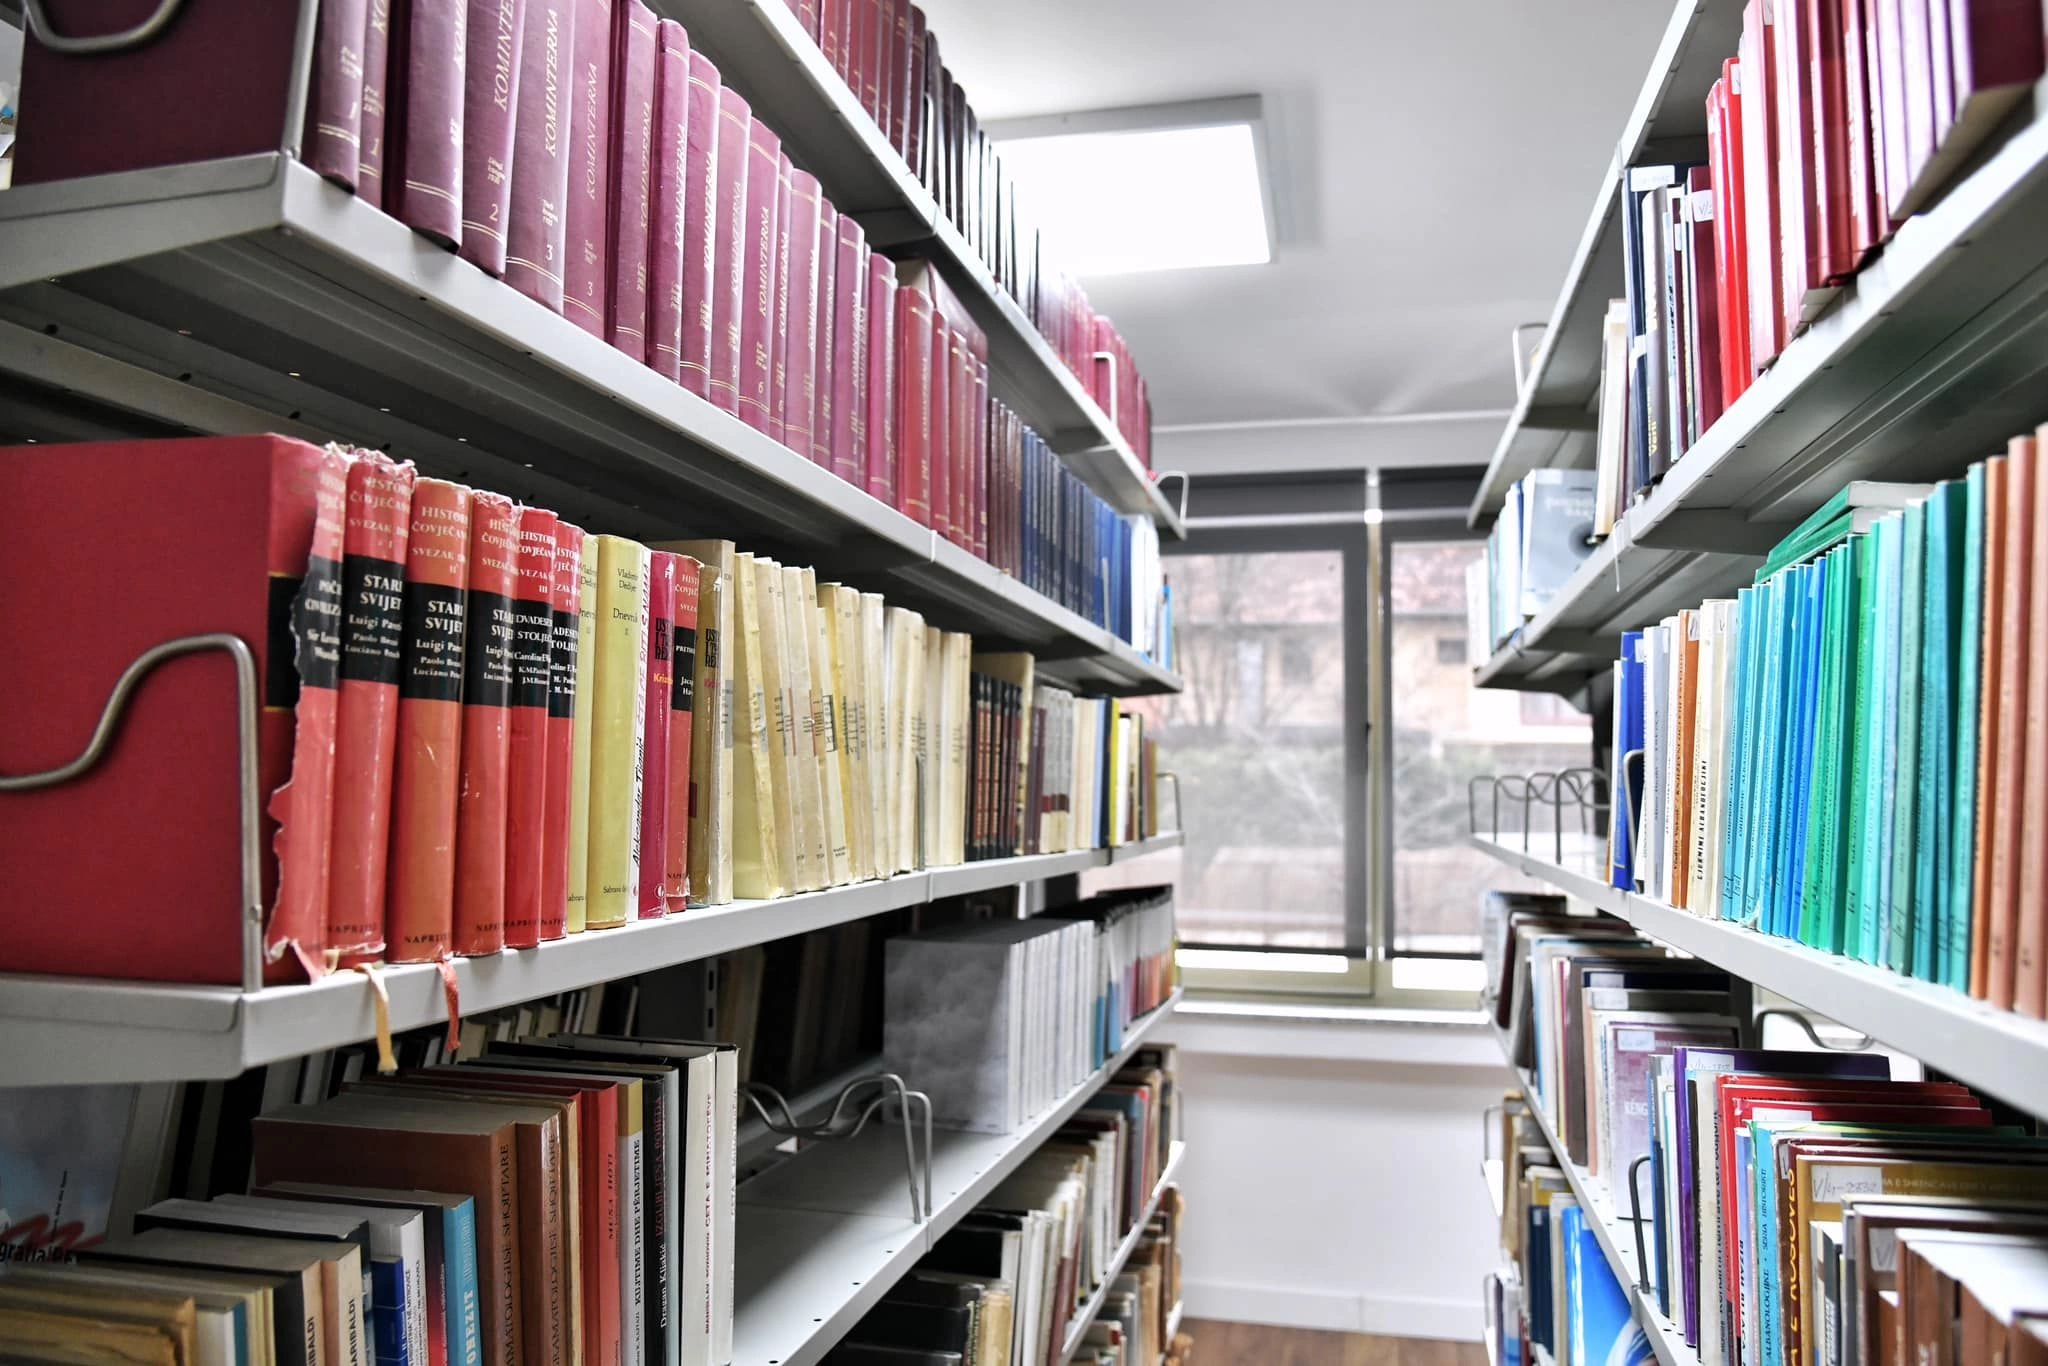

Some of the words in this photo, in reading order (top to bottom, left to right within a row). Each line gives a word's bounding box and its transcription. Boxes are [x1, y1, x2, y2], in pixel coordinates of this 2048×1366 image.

[544, 8, 559, 158] KOMINTERNA
[586, 62, 598, 200] KOMINTERNA
[489, 203, 499, 222] 2
[545, 243, 554, 261] 3
[758, 206, 770, 317] KOMINTERNA
[587, 281, 594, 297] 3
[778, 231, 789, 337] KOMINTERNA
[757, 380, 765, 395] 6
[412, 547, 455, 561] SVEZAK
[363, 574, 403, 593] STARI
[538, 584, 549, 594] III
[360, 591, 402, 612] SVIJET
[427, 600, 463, 617] STARI
[349, 614, 378, 630] Luigi
[425, 617, 463, 635] SVIJET
[416, 638, 445, 654] Luigi
[632, 791, 643, 865] Aleksandar
[548, 1132, 558, 1225] SHQIPTARE
[606, 1153, 614, 1190] HOTI
[632, 1139, 641, 1215] PËRJETIME
[499, 1144, 513, 1237] SHQIPTARE
[632, 1217, 641, 1245] DHE
[633, 1247, 642, 1306] KUJTIME
[659, 1287, 668, 1328] Dragan
